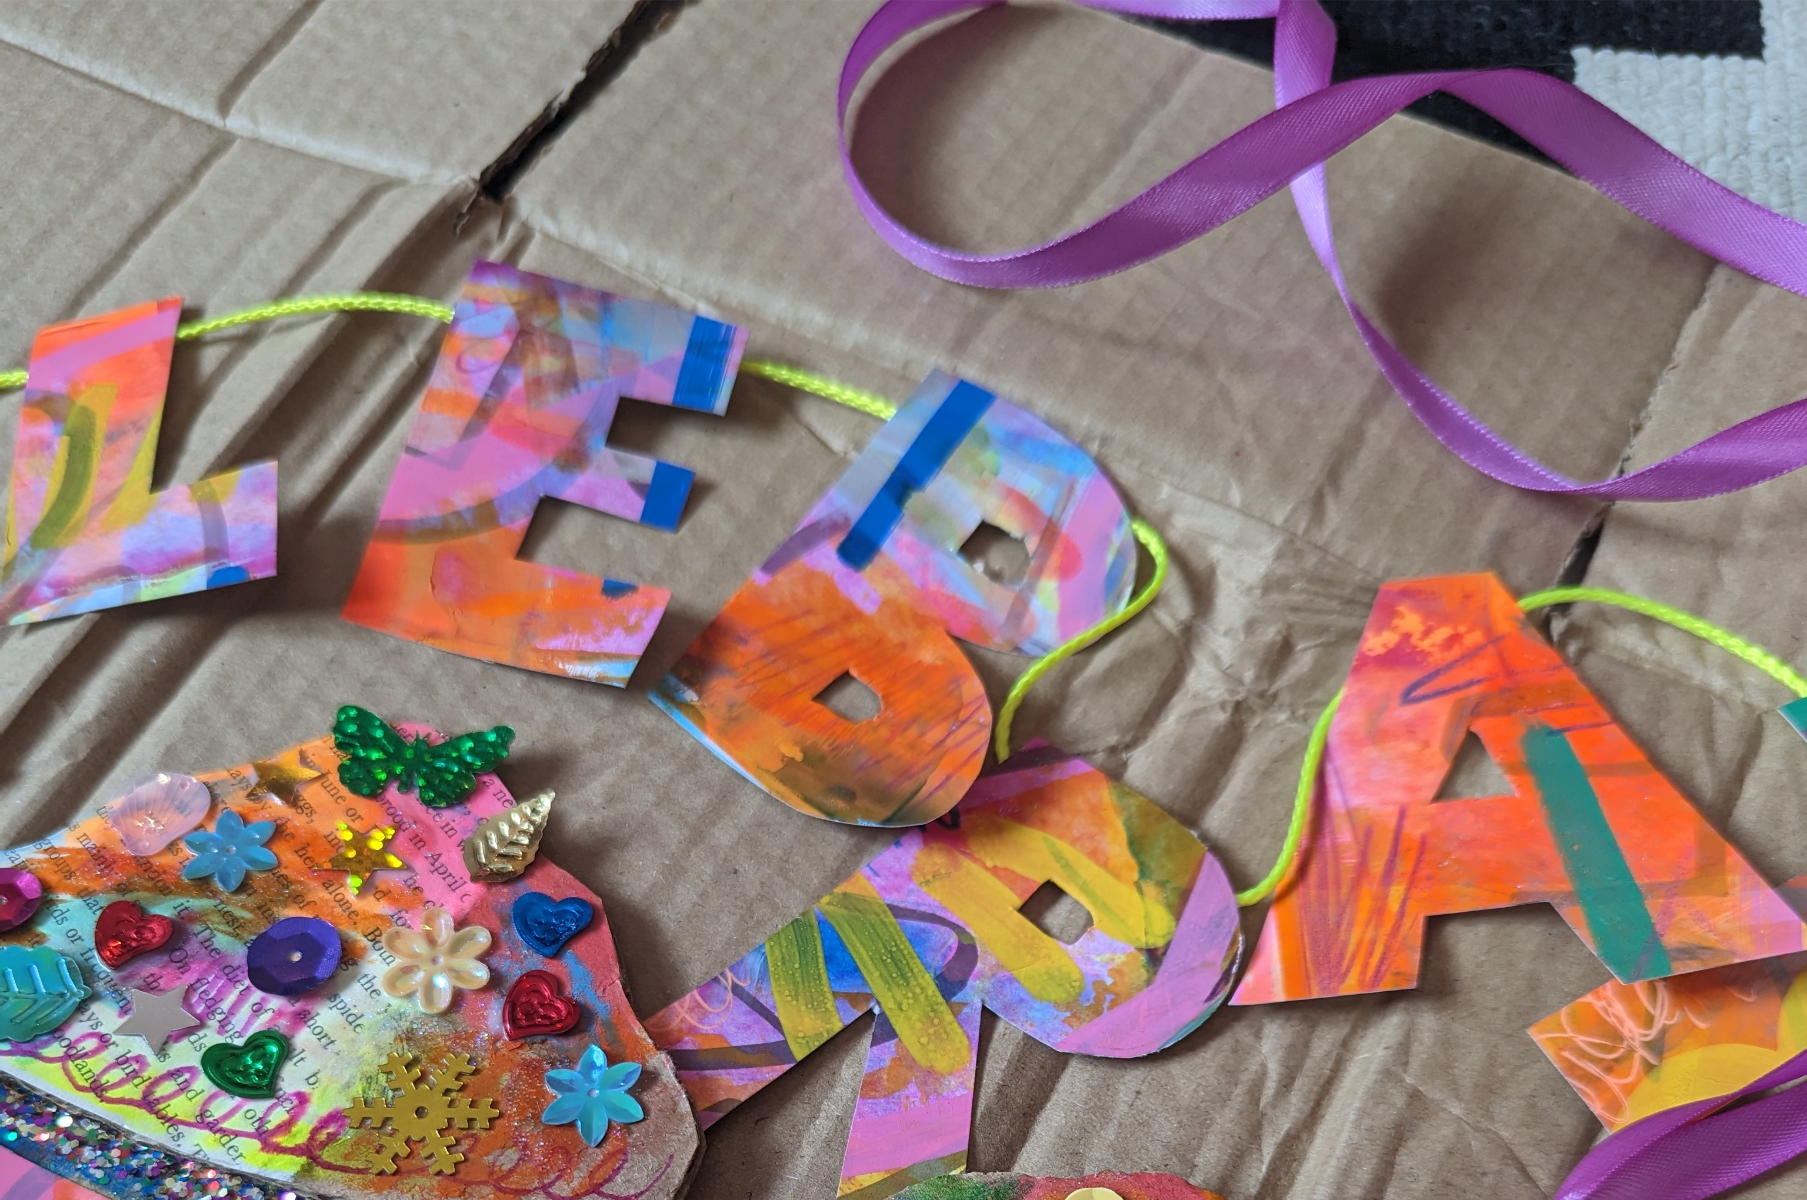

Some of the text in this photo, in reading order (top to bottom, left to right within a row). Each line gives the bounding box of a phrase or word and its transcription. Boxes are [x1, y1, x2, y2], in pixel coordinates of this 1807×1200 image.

[316, 769, 347, 807] June
[344, 805, 363, 826] or
[34, 838, 76, 881] groups
[77, 886, 104, 915] that
[409, 830, 427, 851] in
[424, 846, 466, 892] April
[167, 946, 192, 975] On
[189, 975, 244, 1047] fledging
[173, 897, 195, 919] it.
[192, 923, 225, 959] The
[220, 962, 254, 996] diet
[249, 999, 275, 1022] of
[292, 892, 317, 914] of
[357, 972, 382, 1000] the
[64, 926, 84, 946] or
[170, 1068, 203, 1101] and
[297, 1009, 336, 1051] short
[99, 1031, 119, 1052] or
[115, 1050, 152, 1089] bird
[141, 1089, 190, 1147] tables.
